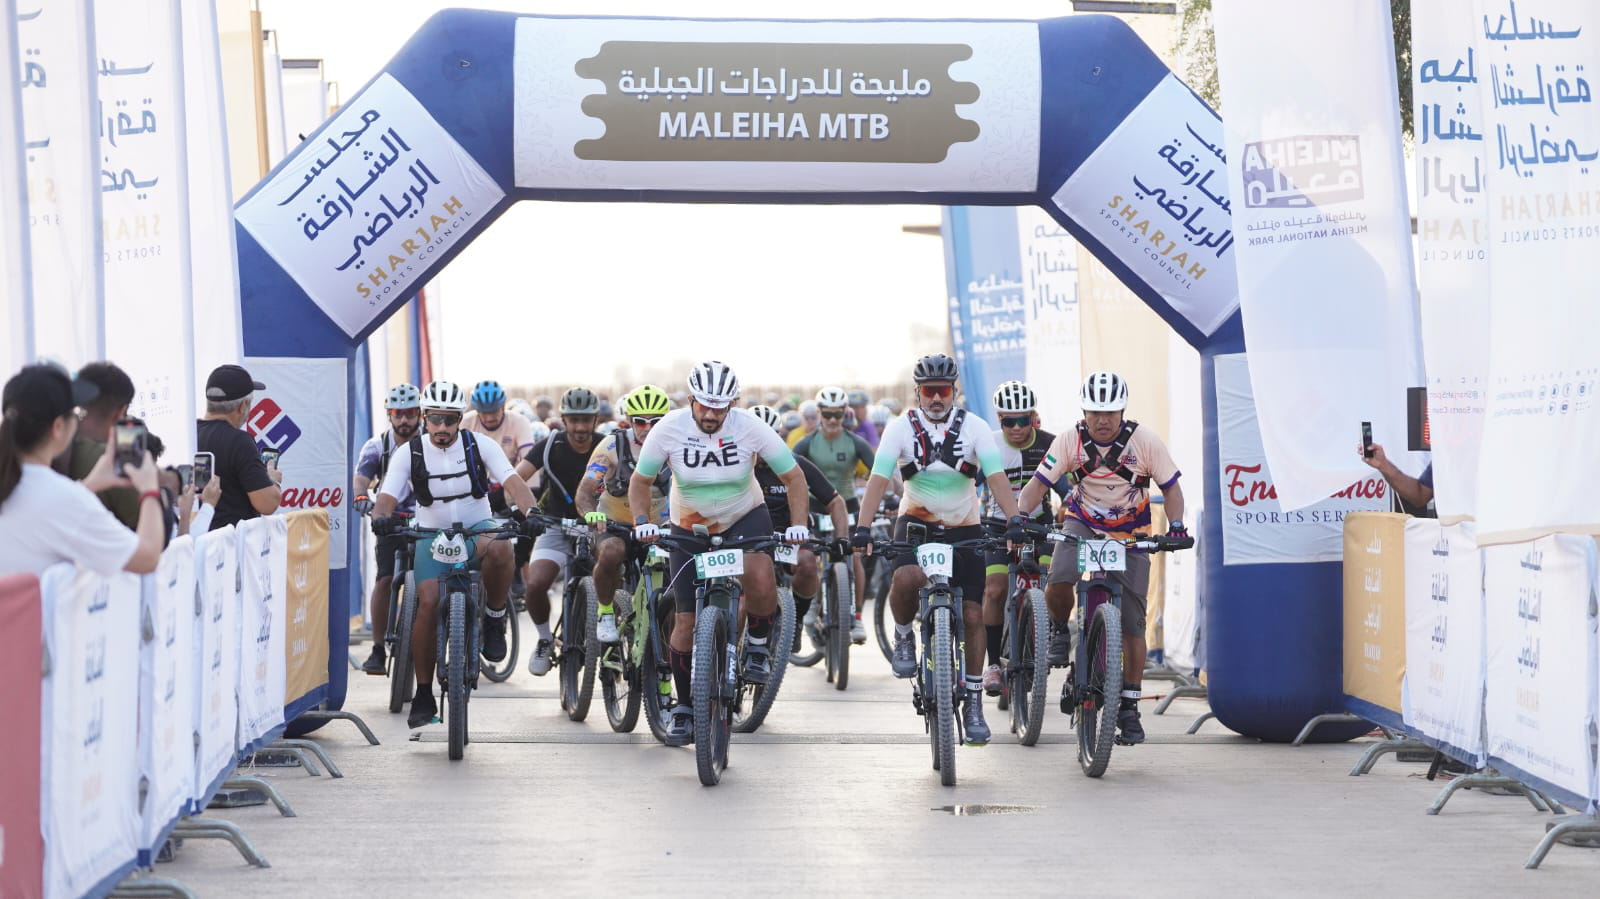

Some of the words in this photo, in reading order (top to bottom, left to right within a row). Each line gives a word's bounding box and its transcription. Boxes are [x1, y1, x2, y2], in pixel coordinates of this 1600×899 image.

[619, 67, 713, 100] الجبلية
[720, 67, 842, 101] للدراجات
[850, 69, 931, 102] مليحة
[658, 112, 810, 139] MALEIHA
[818, 113, 890, 140] MTB
[277, 109, 380, 206] مجلس
[297, 127, 411, 241] الشارقة
[336, 158, 440, 271] الرياضي
[1132, 175, 1234, 258] الرياضي
[356, 196, 463, 298] SHARJAH
[1100, 209, 1138, 244] SPORTS
[1143, 247, 1192, 290] COUNCIL
[1107, 194, 1208, 281] SHARJAH
[369, 265, 412, 306] SPORTS
[418, 210, 472, 260] COUNCIL
[683, 444, 740, 468] UAE
[1235, 511, 1305, 524] SPORTS
[437, 544, 462, 557] 809
[707, 552, 737, 567] 808
[921, 552, 946, 568] 810
[1089, 550, 1118, 563] 813
